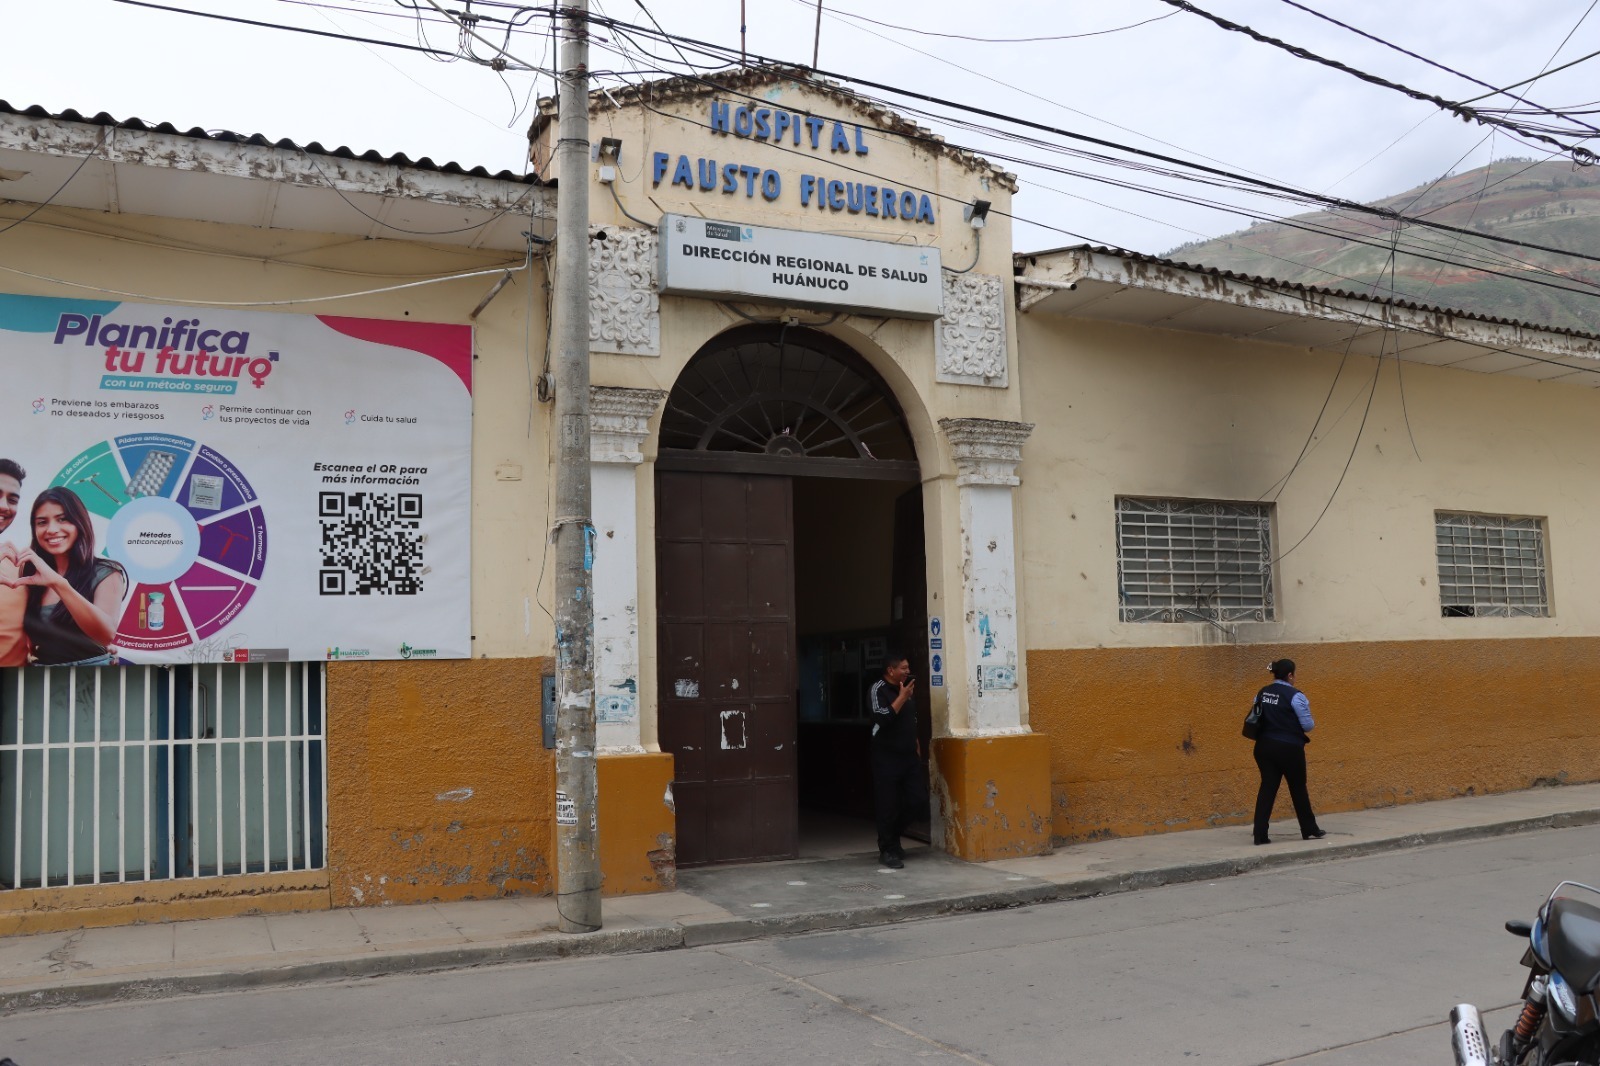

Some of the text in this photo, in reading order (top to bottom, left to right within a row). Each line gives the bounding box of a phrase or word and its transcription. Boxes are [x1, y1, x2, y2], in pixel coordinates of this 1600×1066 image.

[711, 101, 869, 155] HOSPITAL
[653, 152, 782, 201] FAUSTO
[682, 243, 928, 283] DIRECCIÓN REGIONAL DE SALUD
[772, 273, 849, 291] HUÁNUCO
[53, 313, 250, 355] Planifica
[104, 344, 273, 382] tu futuro
[104, 378, 233, 393] con un método seguro
[51, 399, 160, 410] Previene los embarazos
[219, 405, 252, 414] Permite
[254, 406, 294, 416] continuar
[66, 409, 111, 418] deseados
[113, 412, 120, 420] y
[121, 411, 165, 420] riesgosos
[235, 415, 277, 425] proyectos
[279, 416, 290, 425] de
[292, 418, 310, 426] vida
[360, 415, 383, 423] Cuida
[395, 416, 417, 424] salud
[313, 462, 428, 475] Escanea el QR para
[322, 474, 420, 485] más información
[116, 638, 188, 649] Inyectable hormonal
